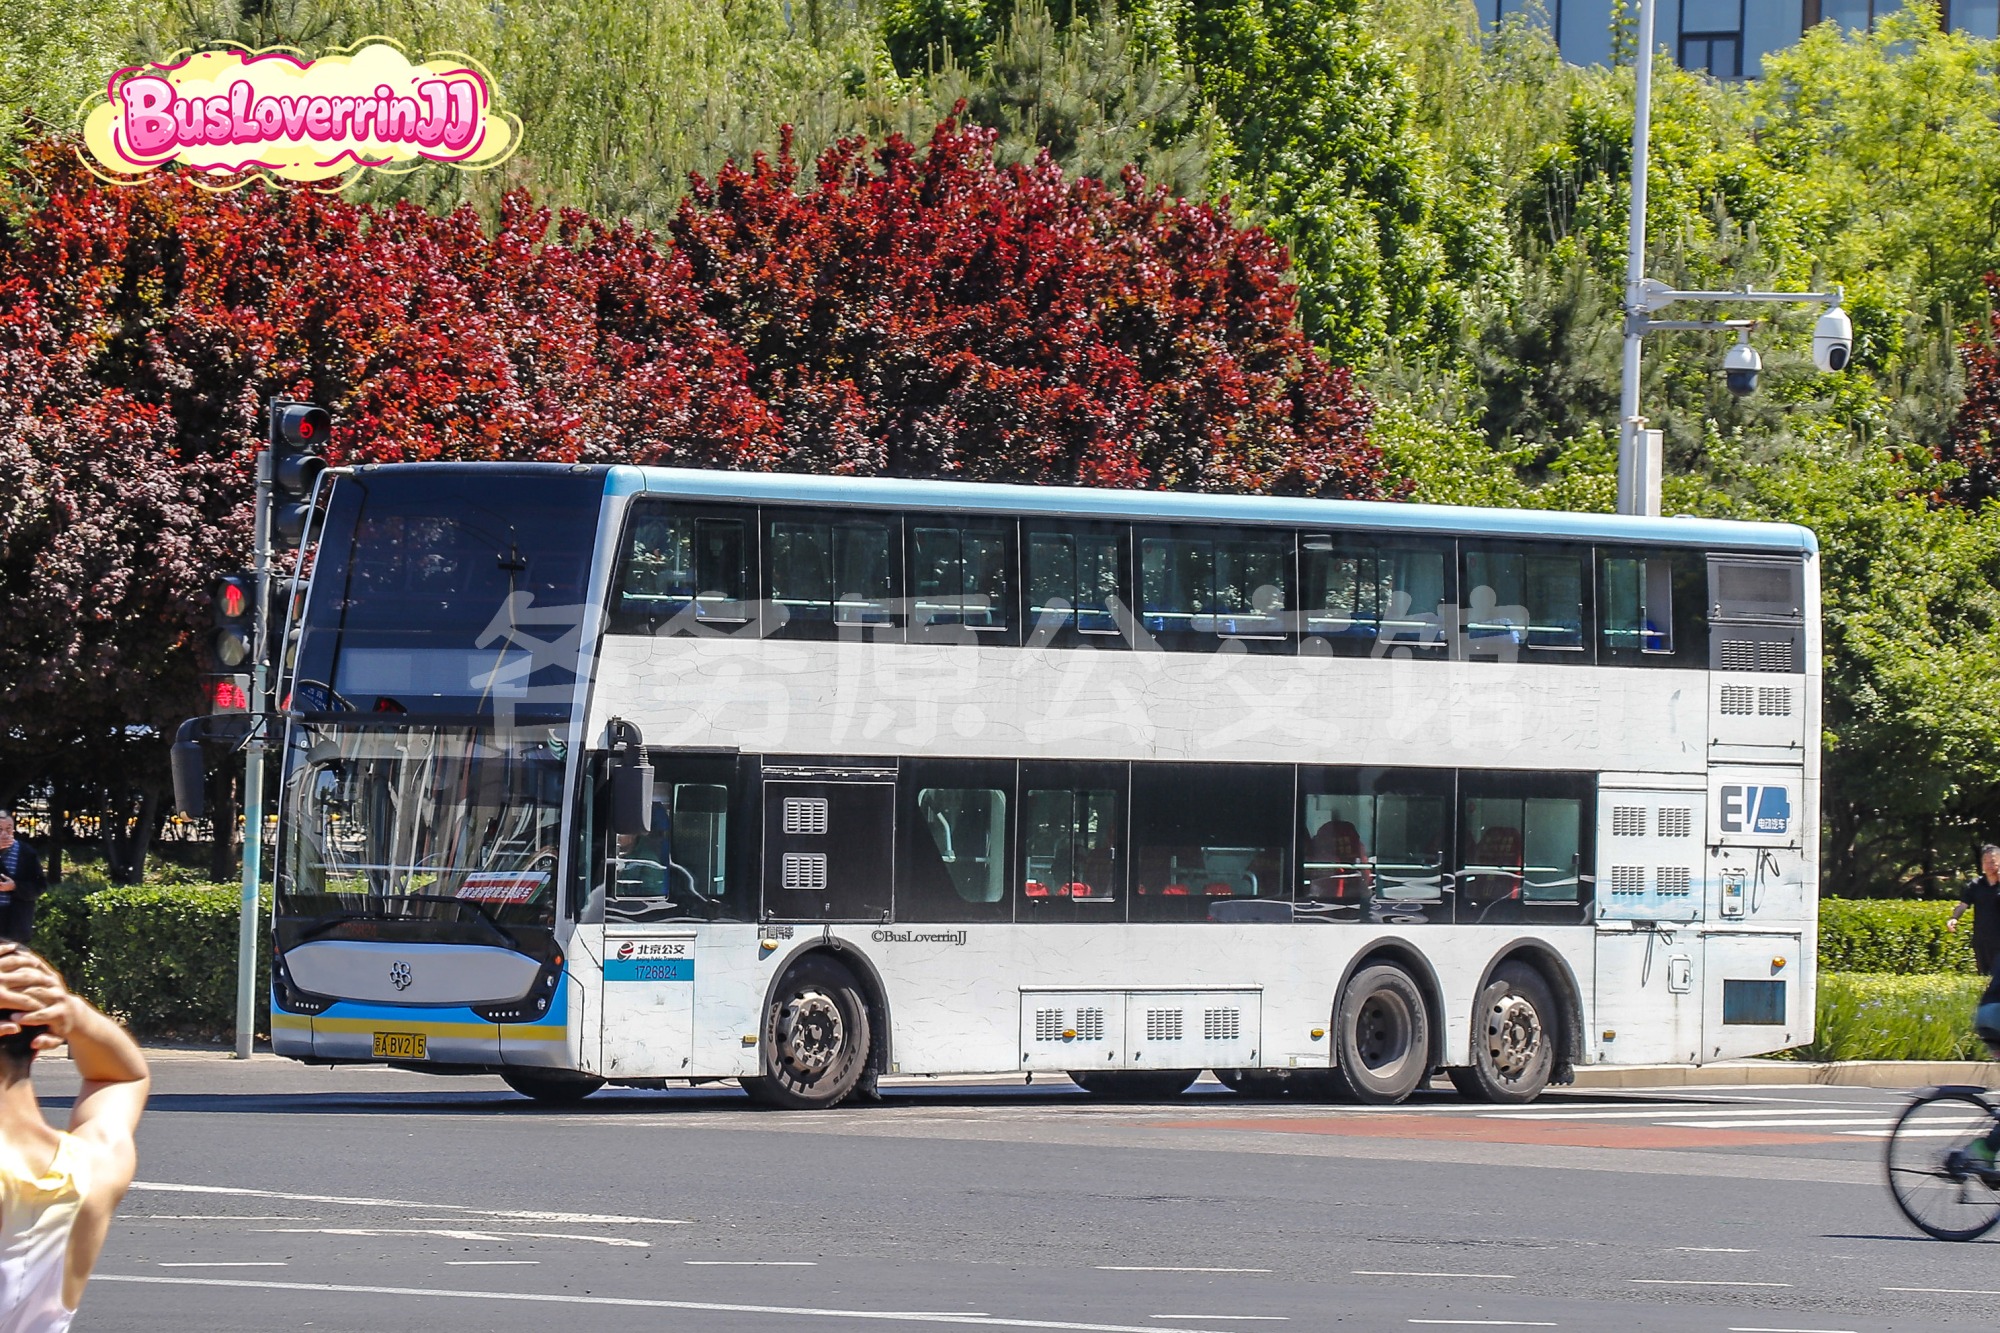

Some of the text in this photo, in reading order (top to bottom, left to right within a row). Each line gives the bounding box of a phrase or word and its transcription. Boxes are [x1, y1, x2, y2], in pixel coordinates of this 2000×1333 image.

[637, 944, 685, 955] 北京公交
[635, 965, 677, 979] 1726824
